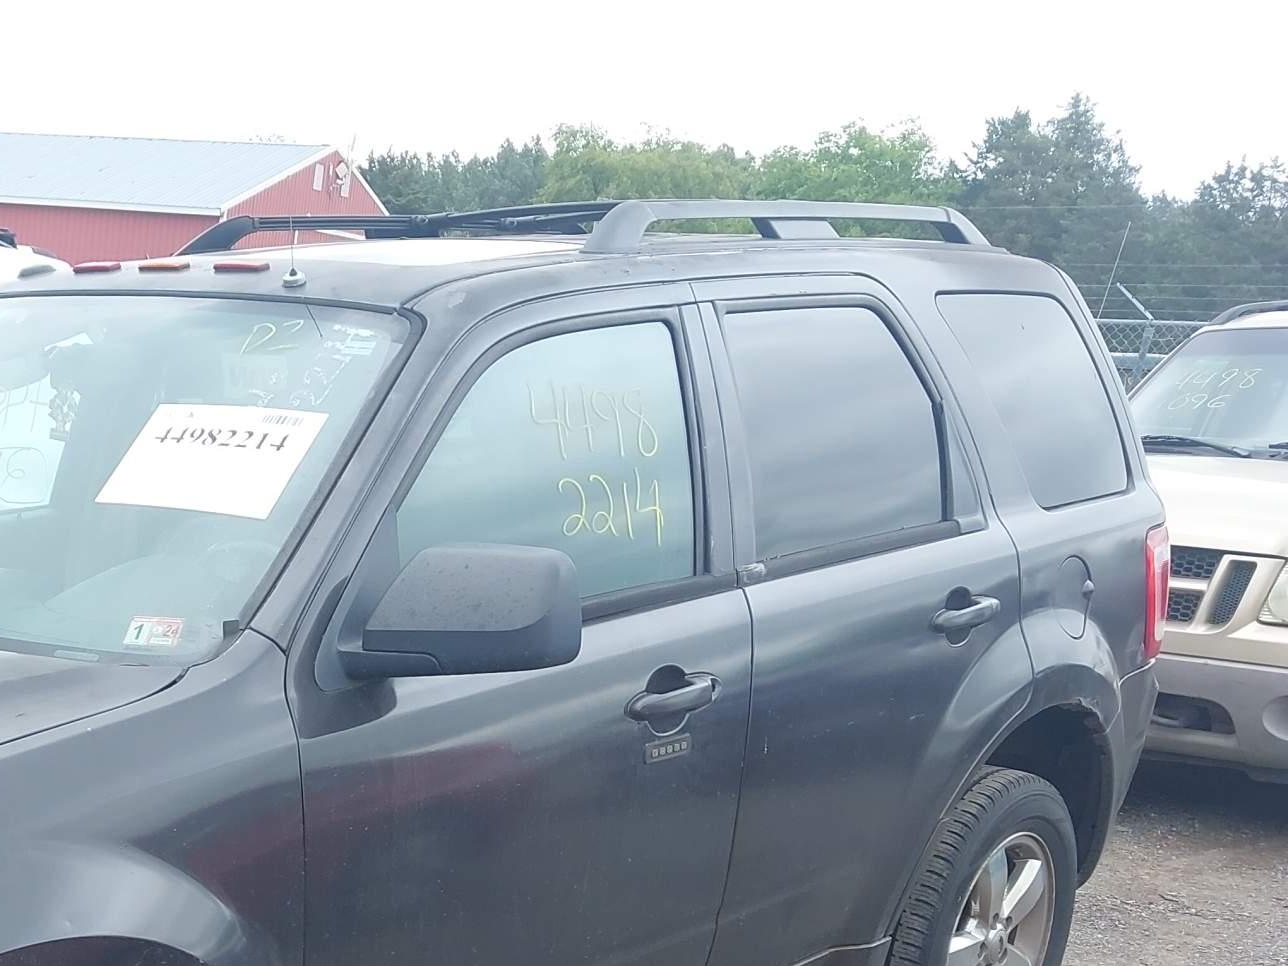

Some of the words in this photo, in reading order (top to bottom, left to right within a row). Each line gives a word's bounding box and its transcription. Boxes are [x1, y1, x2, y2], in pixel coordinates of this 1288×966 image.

[154, 426, 290, 452] 44982214
[526, 380, 658, 460] 4498
[558, 467, 664, 548] 2214
